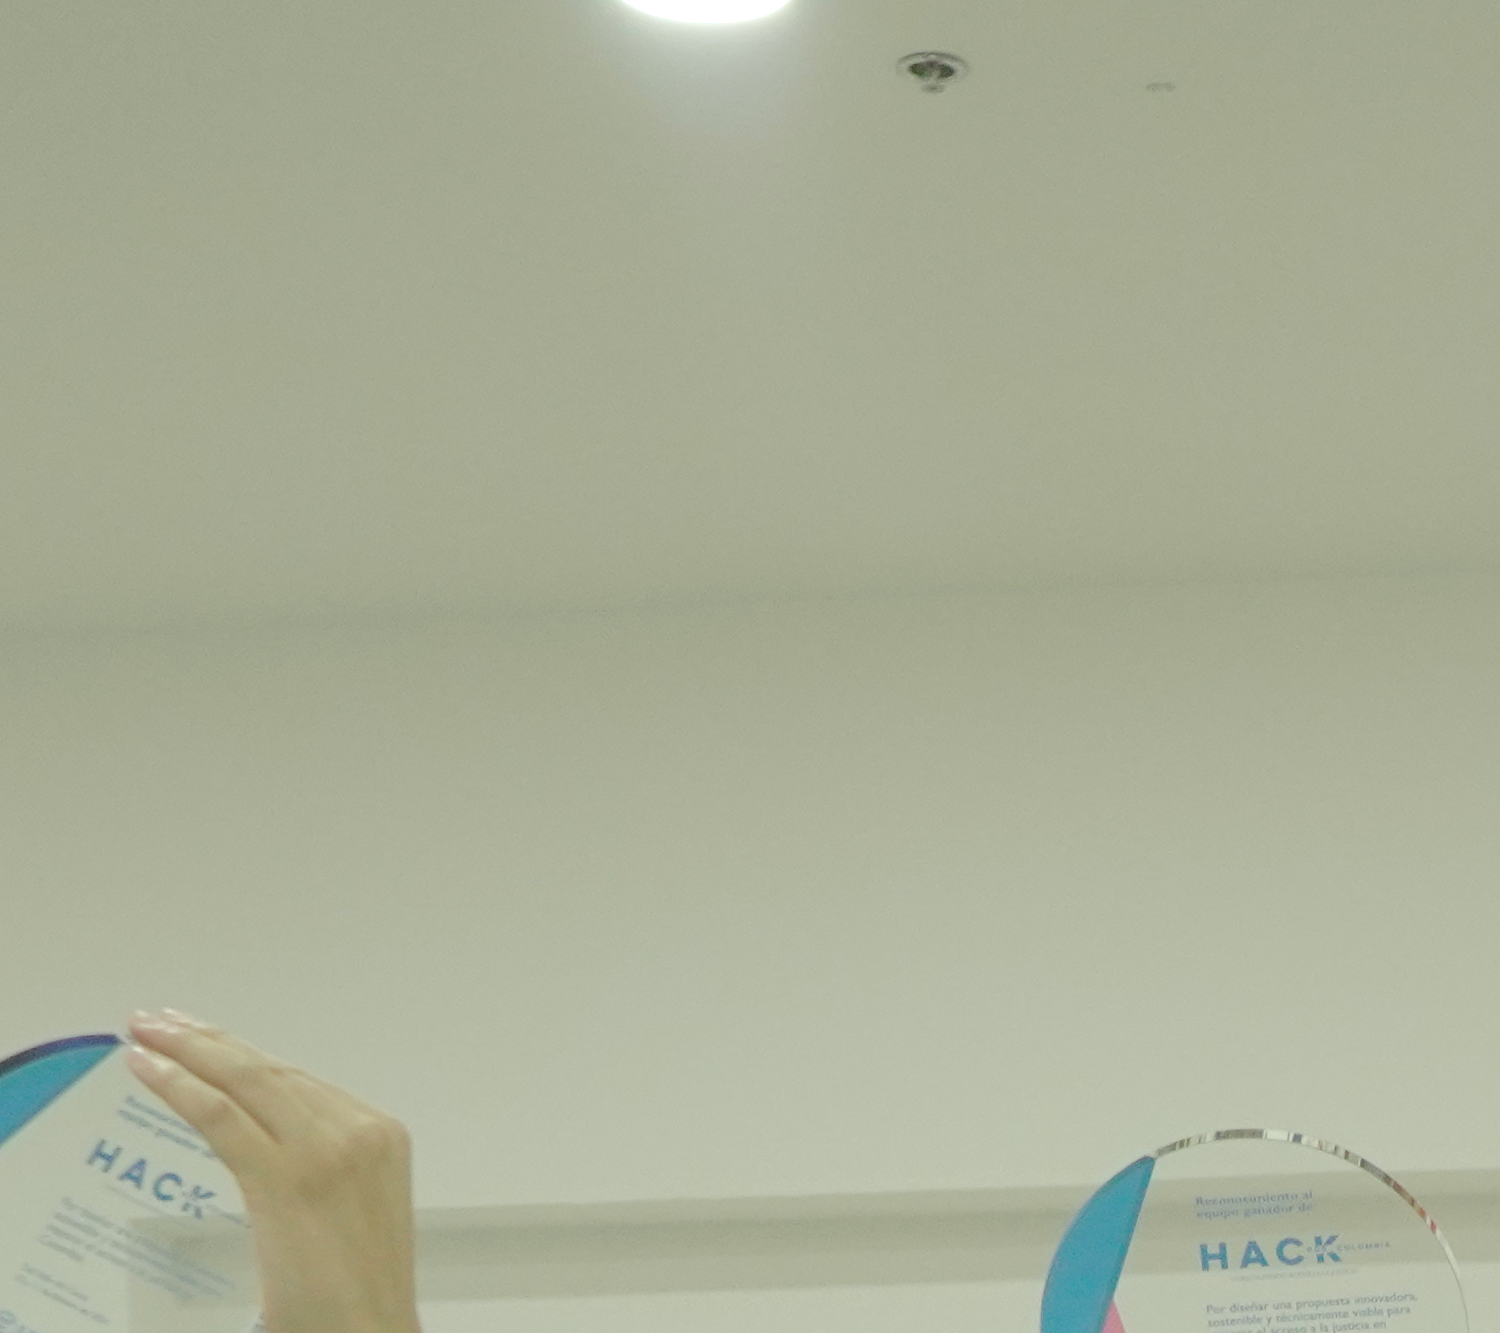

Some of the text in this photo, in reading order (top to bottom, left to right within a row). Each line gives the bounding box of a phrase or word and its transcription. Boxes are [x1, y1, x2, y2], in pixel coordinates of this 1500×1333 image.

[86, 1139, 215, 1220] HACK
[1195, 1190, 1313, 1207] Reconocimiento al
[1196, 1207, 1239, 1220] equipo
[1243, 1205, 1294, 1218] ganador
[1200, 1234, 1342, 1272] HACK
[1336, 1242, 1391, 1253] COLOMBIA
[1206, 1304, 1226, 1314] Por
[1229, 1302, 1268, 1314] diseñar
[1272, 1302, 1292, 1311] una
[1296, 1298, 1351, 1311] propuesta
[1208, 1306, 1411, 1327] sostenible y técnicamente viable para
[1319, 1323, 1329, 1333] la
[1332, 1321, 1370, 1333] justicia
[1373, 1320, 1387, 1330] en
